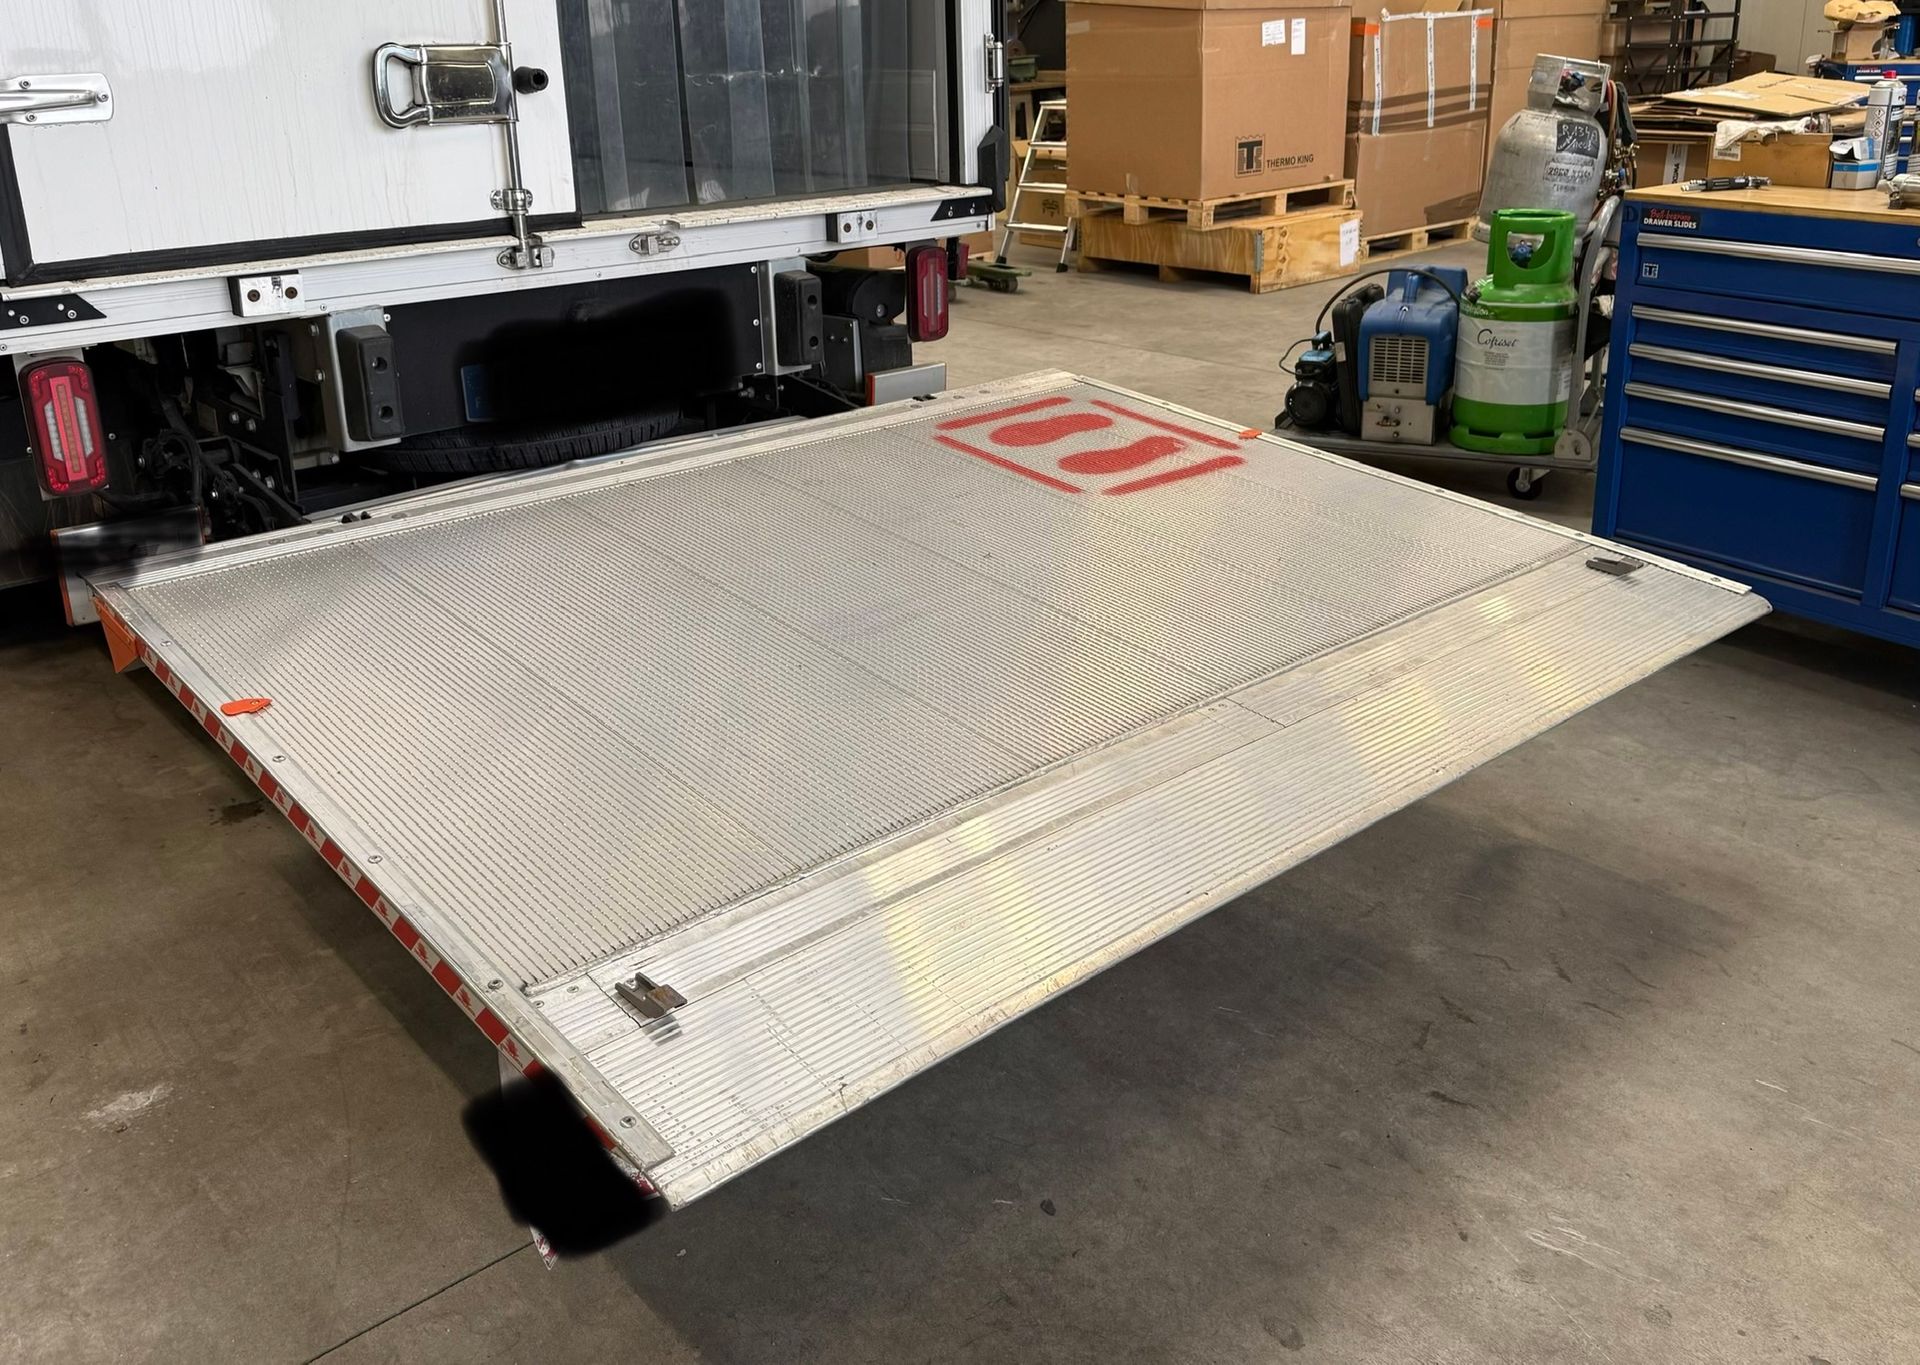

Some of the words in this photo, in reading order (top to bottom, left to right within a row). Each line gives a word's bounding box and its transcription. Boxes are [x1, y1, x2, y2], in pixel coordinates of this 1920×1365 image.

[1267, 156, 1296, 168] THERMO
[1297, 154, 1314, 165] KING
[1643, 217, 1673, 228] DRAWER
[1673, 221, 1697, 230] SLIDES
